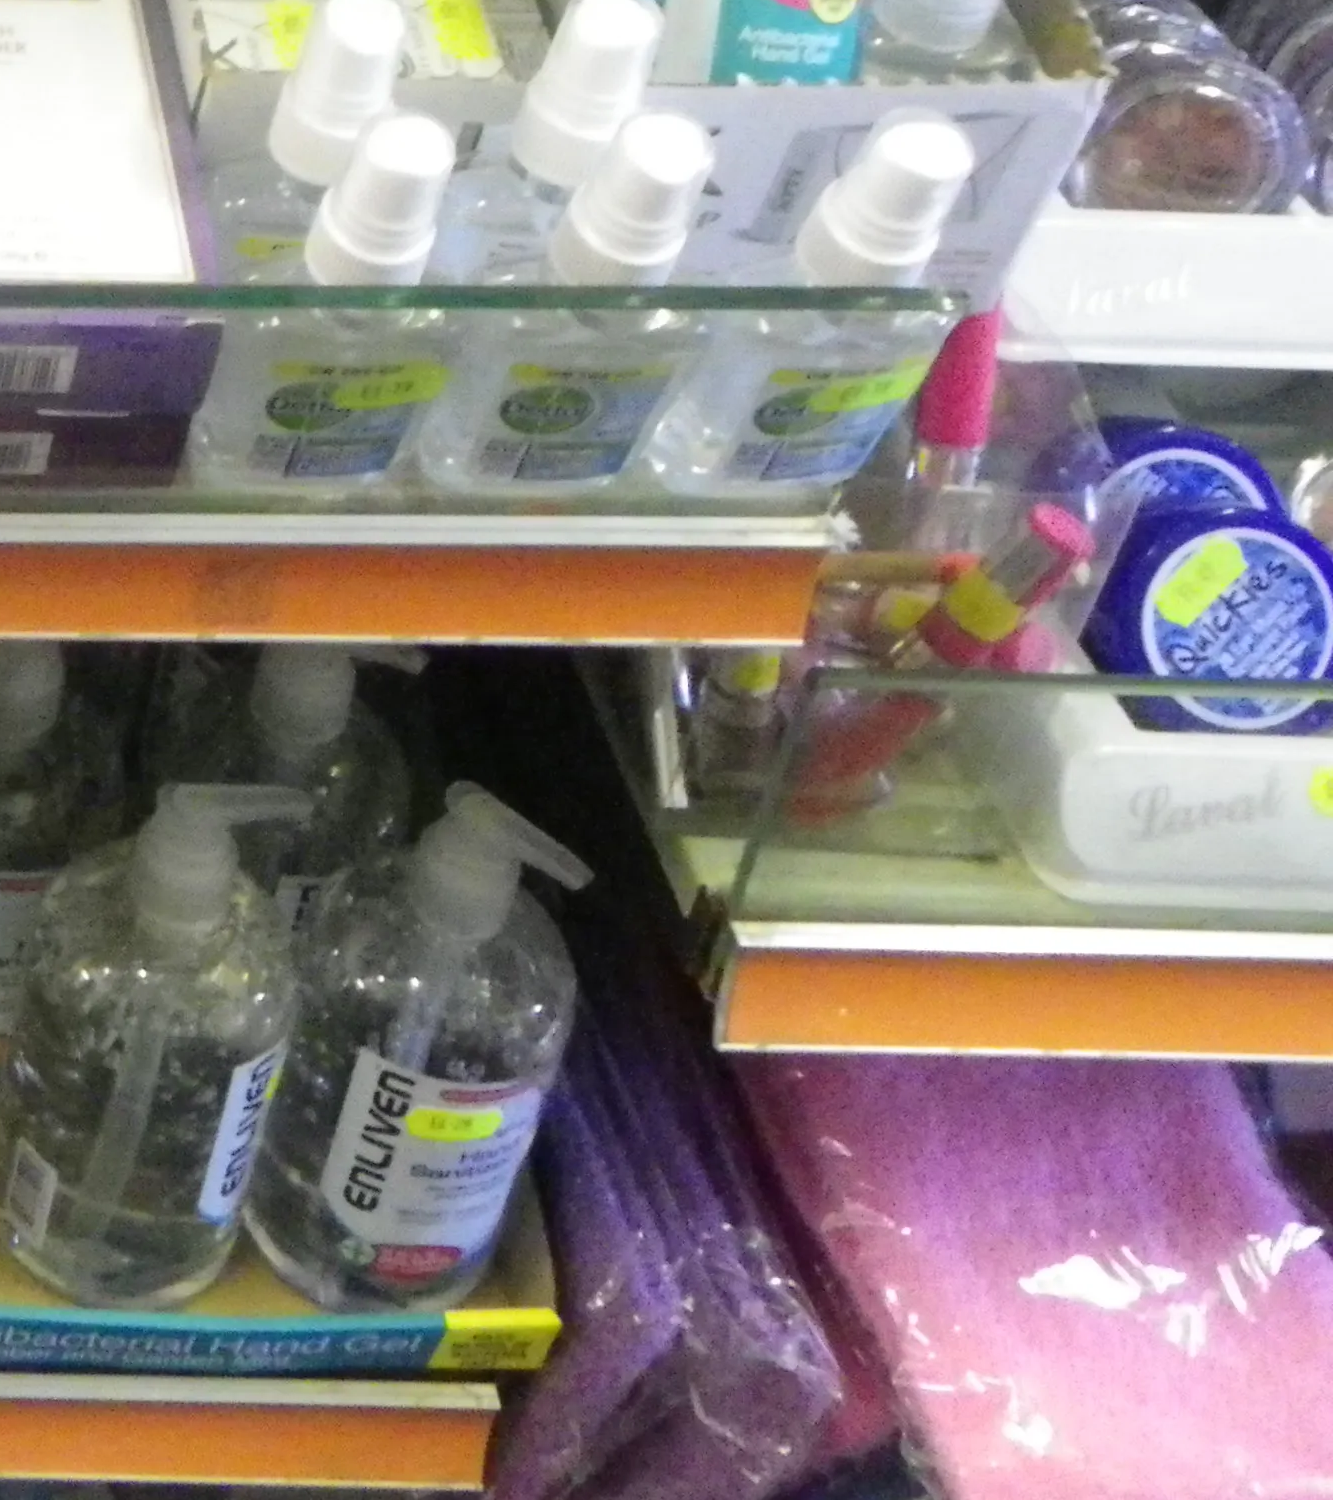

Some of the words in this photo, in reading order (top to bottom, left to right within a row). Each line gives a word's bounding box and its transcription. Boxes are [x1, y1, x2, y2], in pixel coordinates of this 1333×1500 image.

[342, 1069, 416, 1213] ENLIVEN
[210, 1330, 327, 1357] Hand
[338, 1331, 423, 1357] Gel
